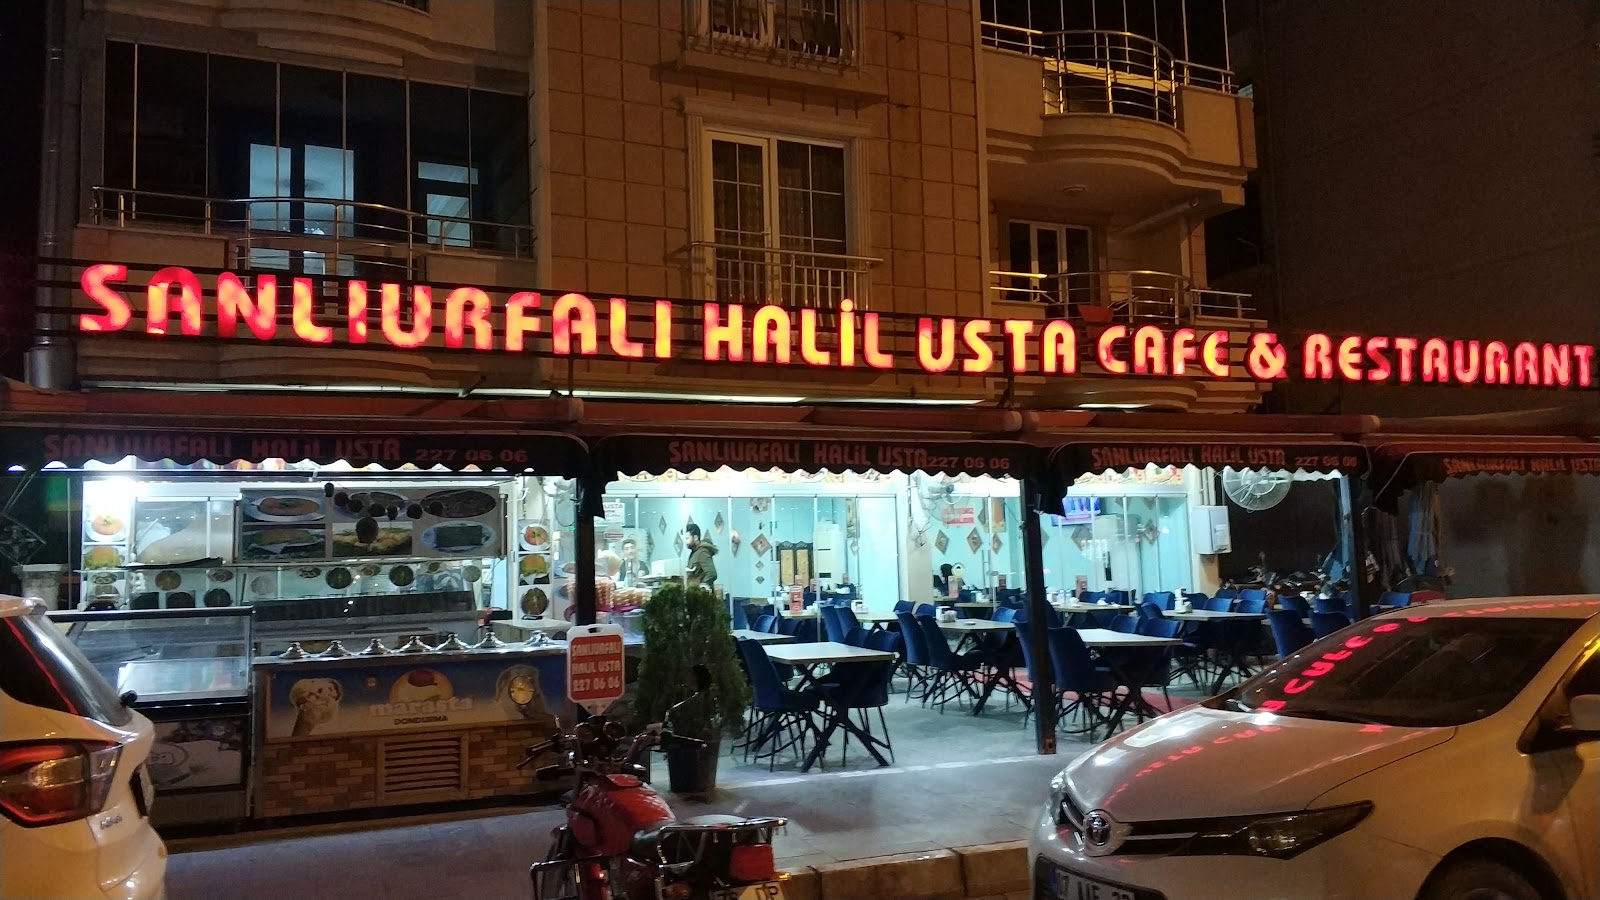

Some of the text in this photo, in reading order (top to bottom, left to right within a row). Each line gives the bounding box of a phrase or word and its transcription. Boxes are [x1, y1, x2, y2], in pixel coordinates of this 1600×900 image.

[79, 264, 1594, 387] SANLIURFALI HALİL USTA CAFE & RESTAURANT
[335, 437, 401, 460] USTA
[415, 448, 459, 461] 227
[464, 449, 494, 462] 06
[498, 449, 529, 462] 06
[878, 444, 927, 467] USTA
[927, 455, 957, 468] 227
[963, 456, 986, 469] 06
[989, 457, 1011, 470] 06
[1248, 448, 1286, 466] USTA
[1294, 456, 1319, 467] 227
[598, 659, 621, 673] USTA
[572, 675, 621, 692] 227 06 06
[393, 715, 449, 726] DONDURMA
